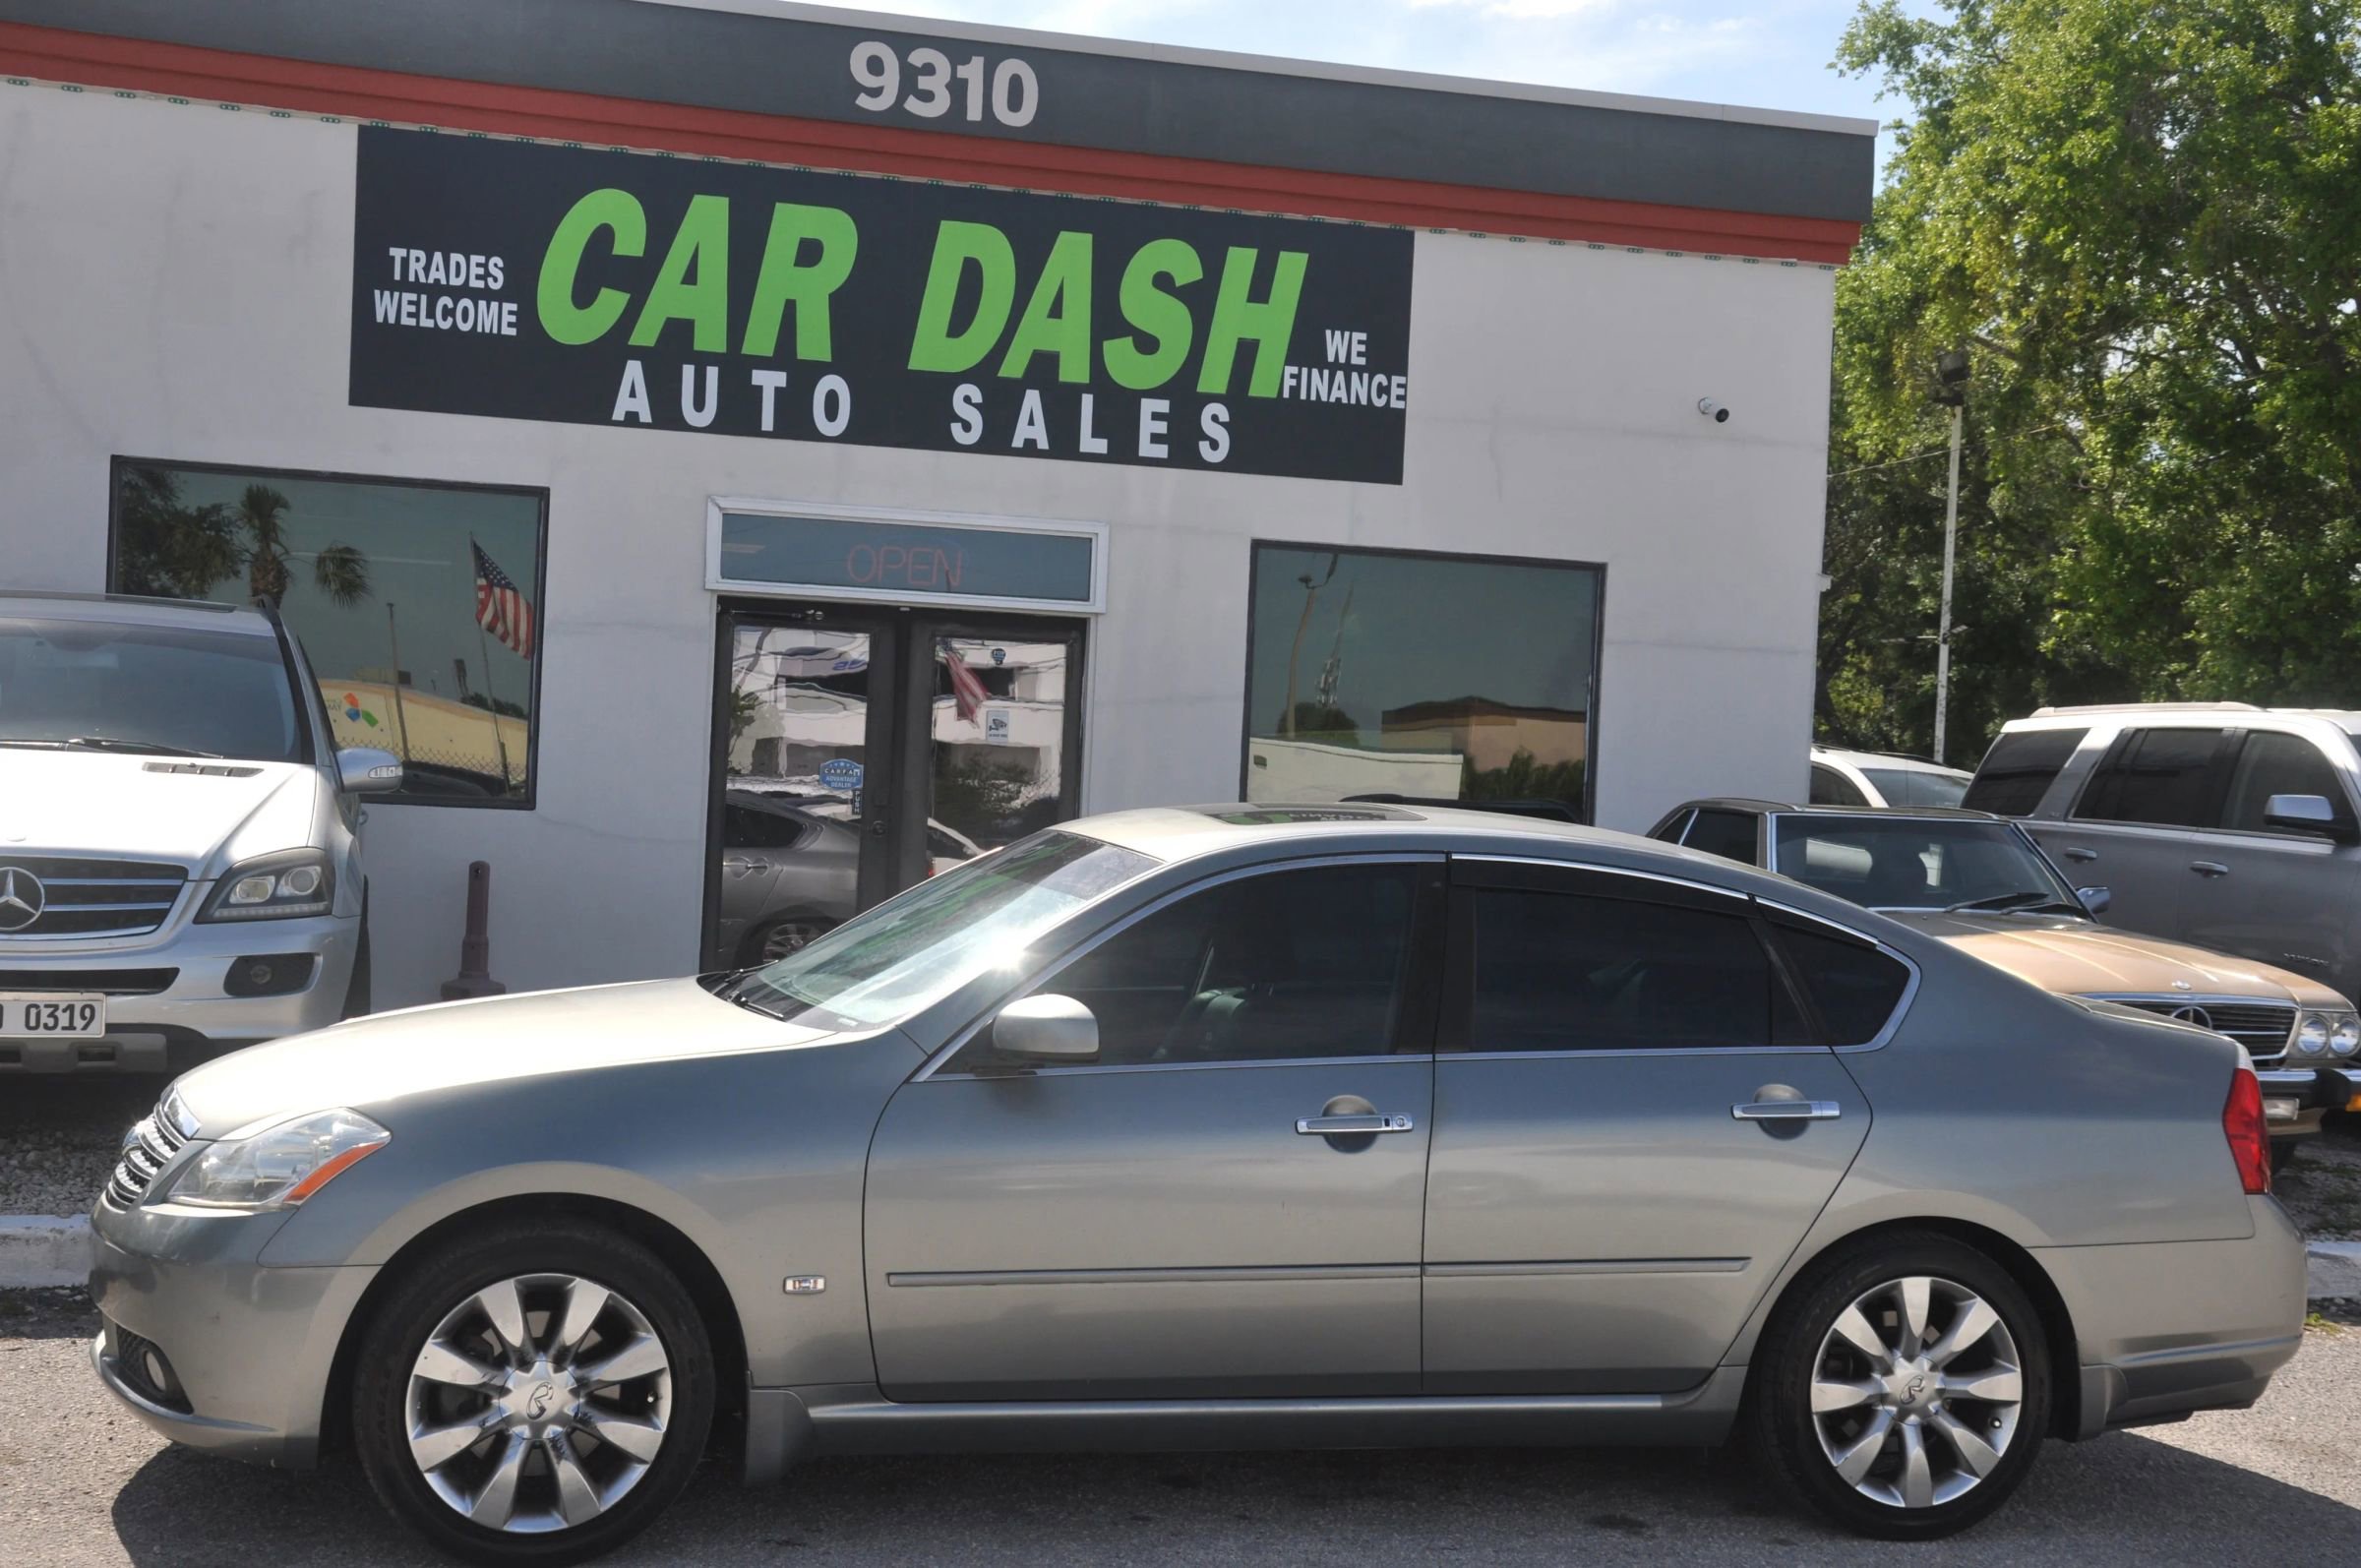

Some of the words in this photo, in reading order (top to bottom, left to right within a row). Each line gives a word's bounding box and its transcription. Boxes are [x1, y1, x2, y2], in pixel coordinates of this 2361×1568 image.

[849, 40, 1039, 127] 9310
[389, 247, 505, 290] TRADES
[374, 289, 518, 335] WELCOME
[536, 187, 859, 362] CAR
[907, 219, 1309, 398] DASH
[1325, 329, 1367, 365] WE
[1282, 365, 1407, 409] FINANCE
[612, 360, 852, 437] AUTO
[949, 384, 1231, 463] SALES
[847, 543, 963, 587] OPEN
[25, 1003, 95, 1031] 0319
